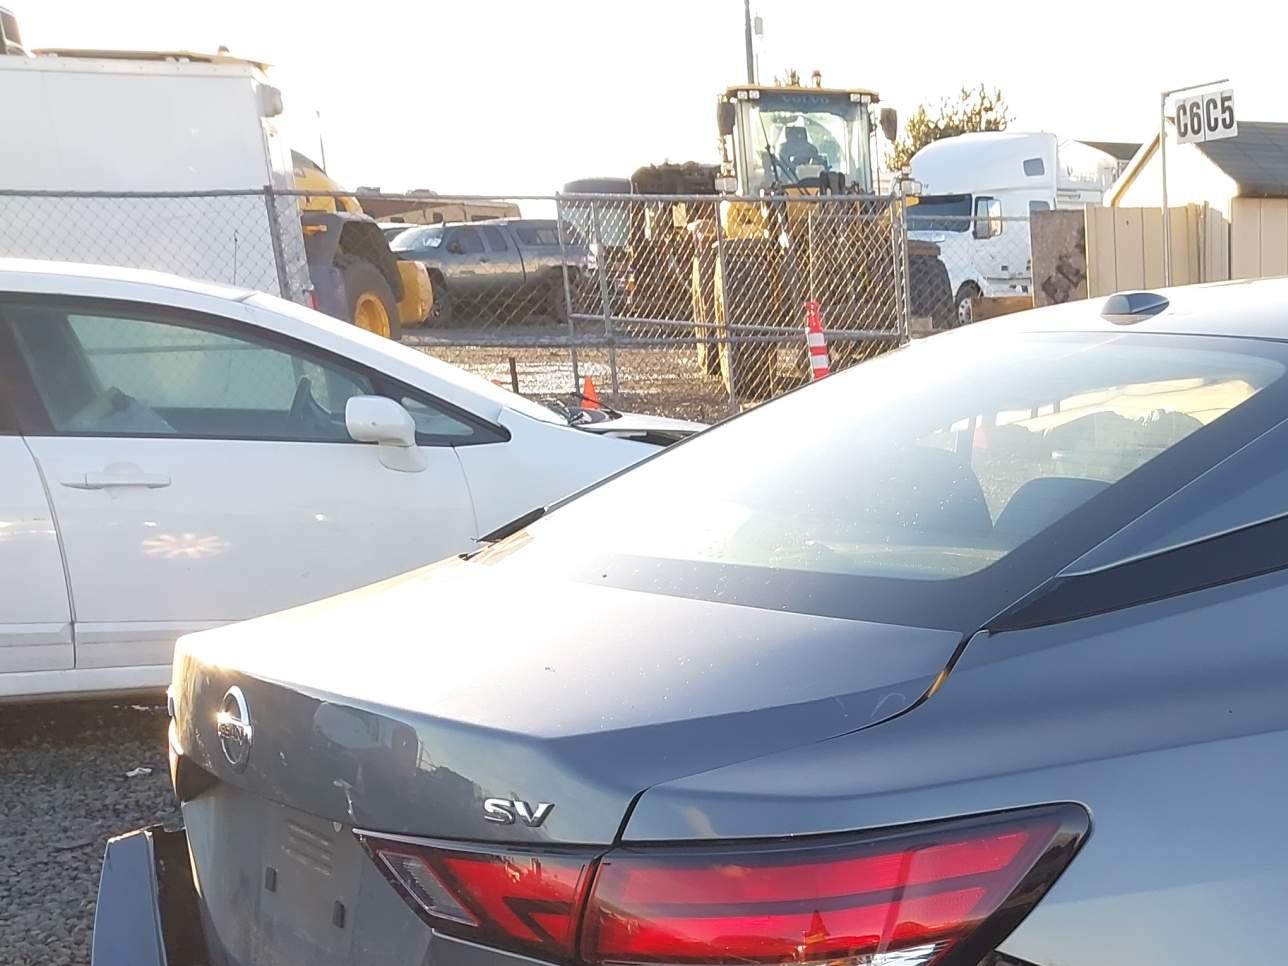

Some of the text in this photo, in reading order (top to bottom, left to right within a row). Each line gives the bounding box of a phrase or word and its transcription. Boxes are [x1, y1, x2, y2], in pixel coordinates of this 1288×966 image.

[1176, 95, 1235, 137] C6 C5
[483, 797, 555, 828] SV
